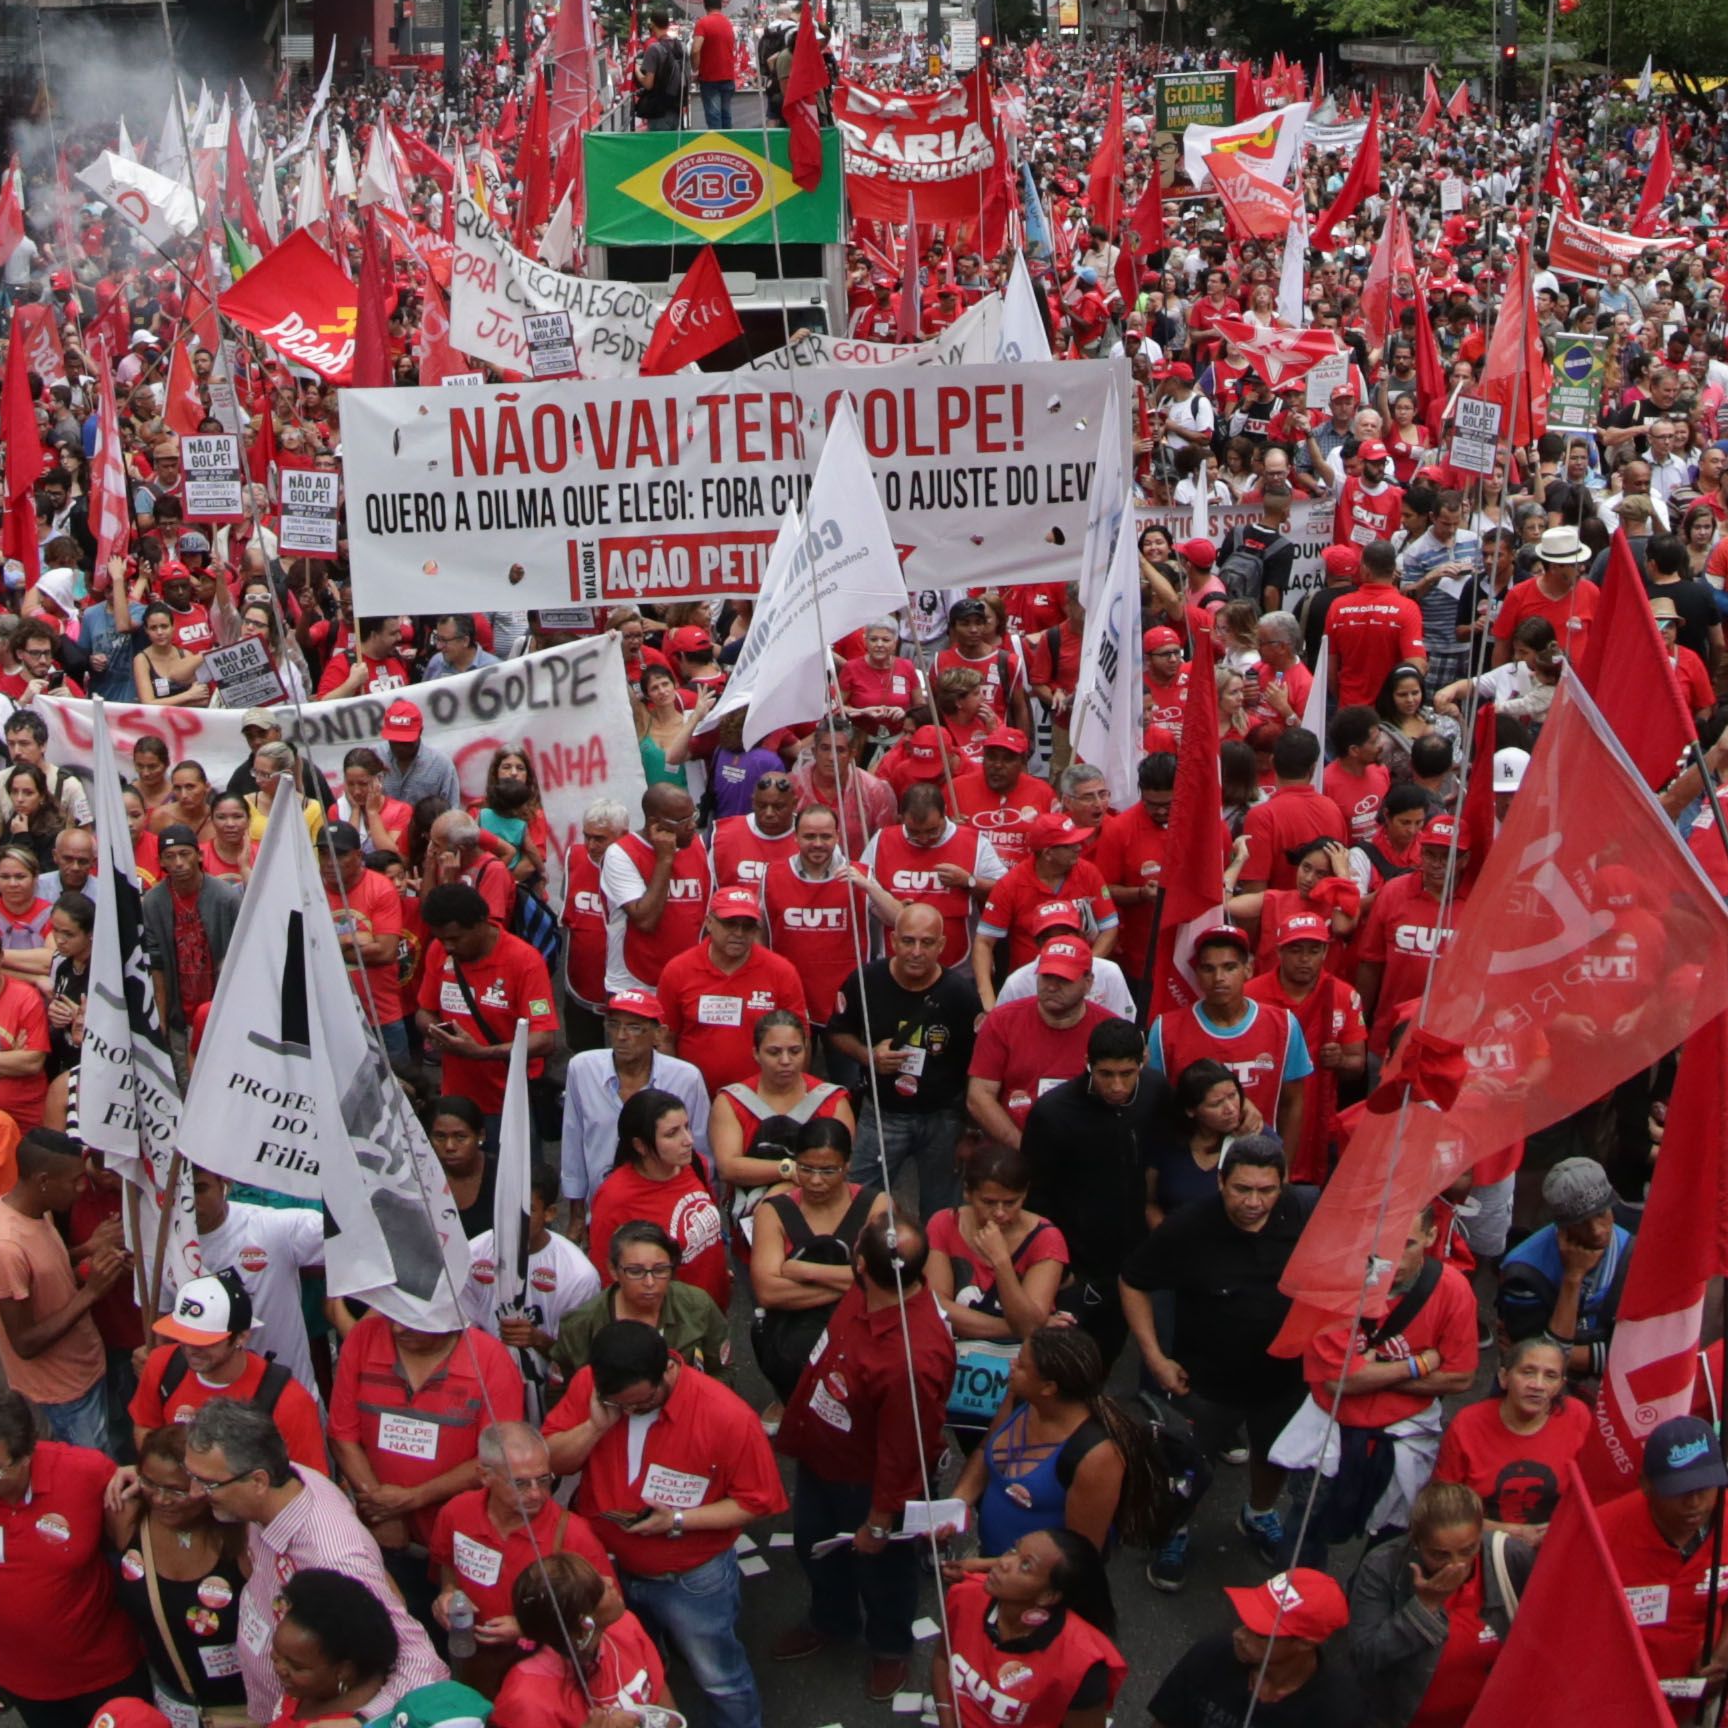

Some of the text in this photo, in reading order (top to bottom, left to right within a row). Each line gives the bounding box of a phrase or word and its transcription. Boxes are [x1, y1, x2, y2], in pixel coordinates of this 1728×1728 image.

[1164, 83, 1226, 104] GOLPE
[676, 154, 751, 173] METALÚRGICOS
[888, 146, 995, 183] SOCIALISMO
[673, 172, 755, 201] ABC
[530, 315, 563, 330] NÃO AO
[262, 307, 354, 375] PCdoB
[533, 325, 564, 341] GOLPE!
[1461, 402, 1479, 415] NÃO
[449, 392, 568, 478] NÃO
[585, 398, 679, 471] VAI
[696, 392, 806, 464] TER
[188, 439, 231, 454] NÃO AO
[191, 453, 232, 469] GOLPE!
[290, 475, 331, 489] NÃO AO
[290, 489, 331, 504] GOLPE!
[366, 491, 448, 537] QUERO
[455, 491, 472, 532] A
[477, 486, 557, 531] DILMA
[562, 483, 612, 529] QUE
[619, 479, 694, 523] ELEGI:
[703, 476, 764, 520] FORA
[886, 470, 902, 512] O
[909, 466, 998, 510] AJUSTE
[1006, 464, 1037, 506] DO
[1351, 505, 1388, 526] CUT
[584, 540, 597, 600] DIÁLOGO E
[605, 538, 691, 596] AÇÃO
[179, 622, 210, 641] CUT
[213, 643, 257, 666] NÃO AO
[218, 654, 265, 676] GOLPE!
[429, 688, 459, 721] O
[390, 715, 410, 724] CUT
[892, 869, 942, 890] CUT
[784, 909, 841, 928] CUT
[1289, 916, 1317, 929] CUT
[1048, 943, 1076, 956] CUT
[383, 1424, 433, 1438] GOLPE
[389, 1441, 425, 1454] NÃO!
[651, 1474, 703, 1489] GOLPE
[653, 1492, 692, 1504] NÃO!
